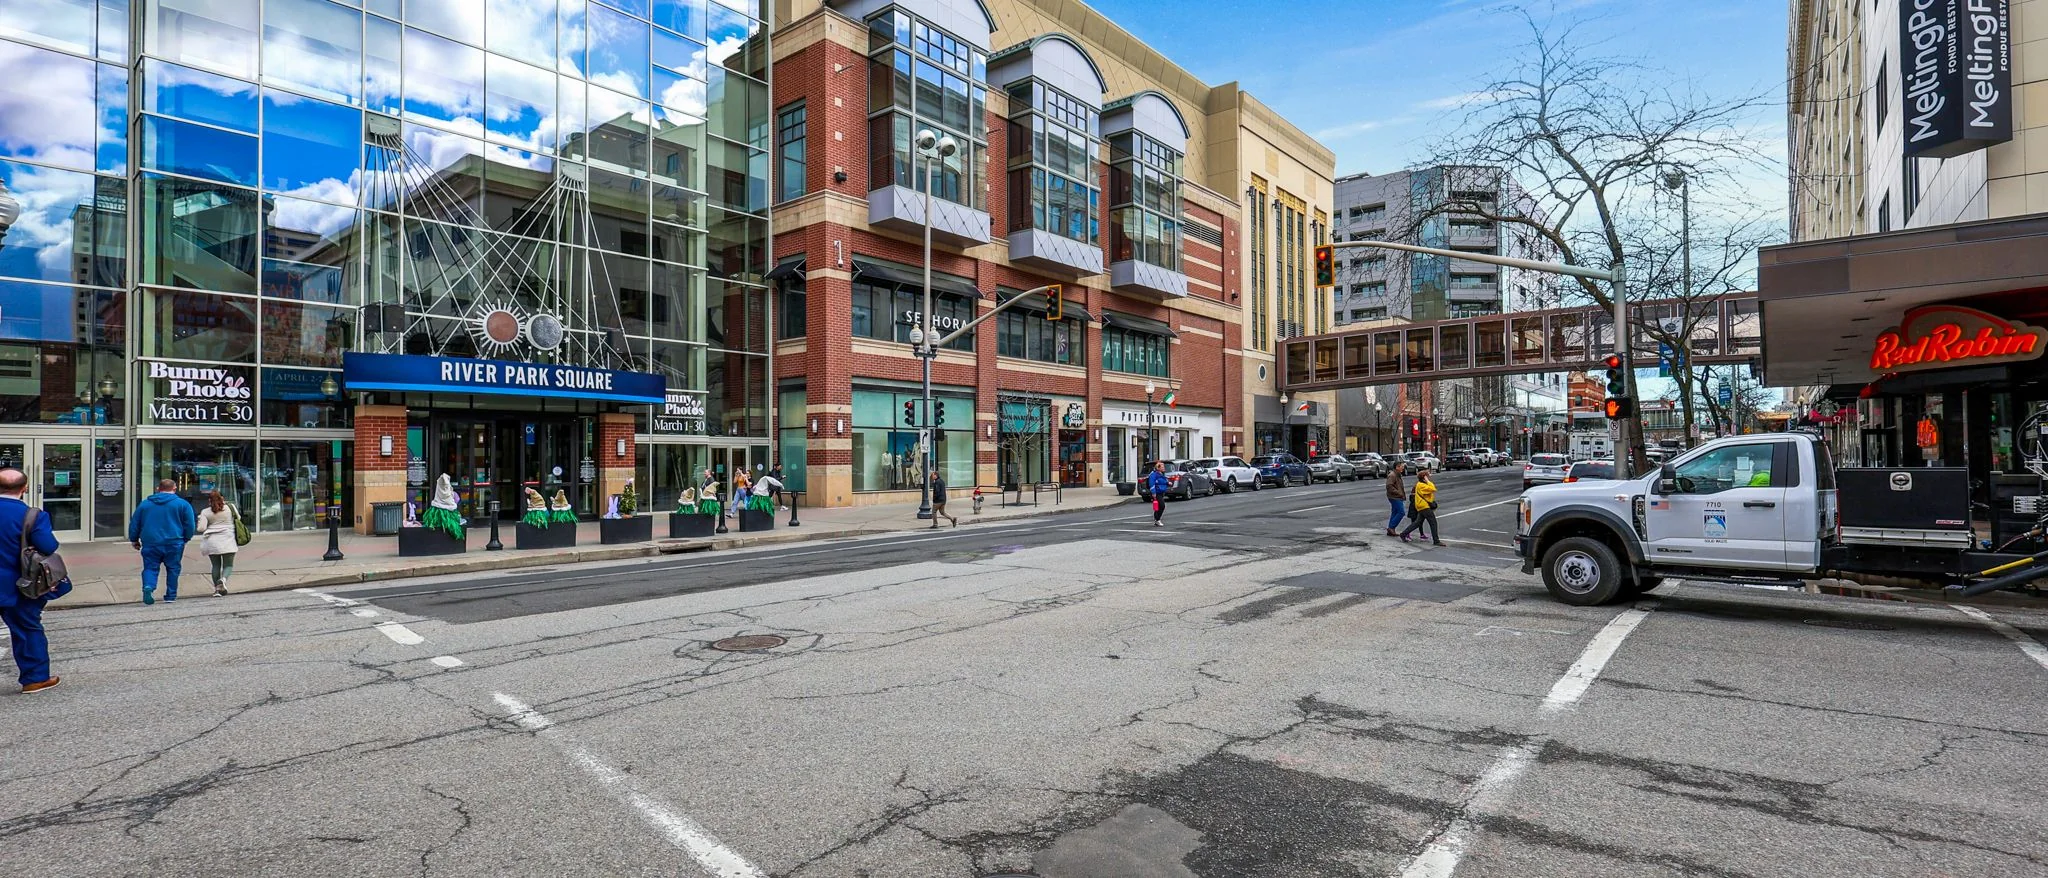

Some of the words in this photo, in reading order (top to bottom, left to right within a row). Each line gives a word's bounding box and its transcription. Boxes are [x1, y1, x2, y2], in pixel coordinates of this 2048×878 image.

[1947, 32, 1957, 75] FONDUE
[2000, 30, 2008, 71] FONDUE
[906, 310, 967, 330] SEHORA
[1921, 323, 2038, 362] Robin
[148, 361, 228, 385] Bunny
[441, 361, 497, 383] RIVER
[505, 365, 549, 387] PARK
[555, 369, 613, 391] SQUARE
[169, 379, 251, 399] Photos
[664, 403, 705, 416] Photos
[665, 393, 693, 407] unny
[148, 403, 207, 420] March
[654, 419, 683, 431] March
